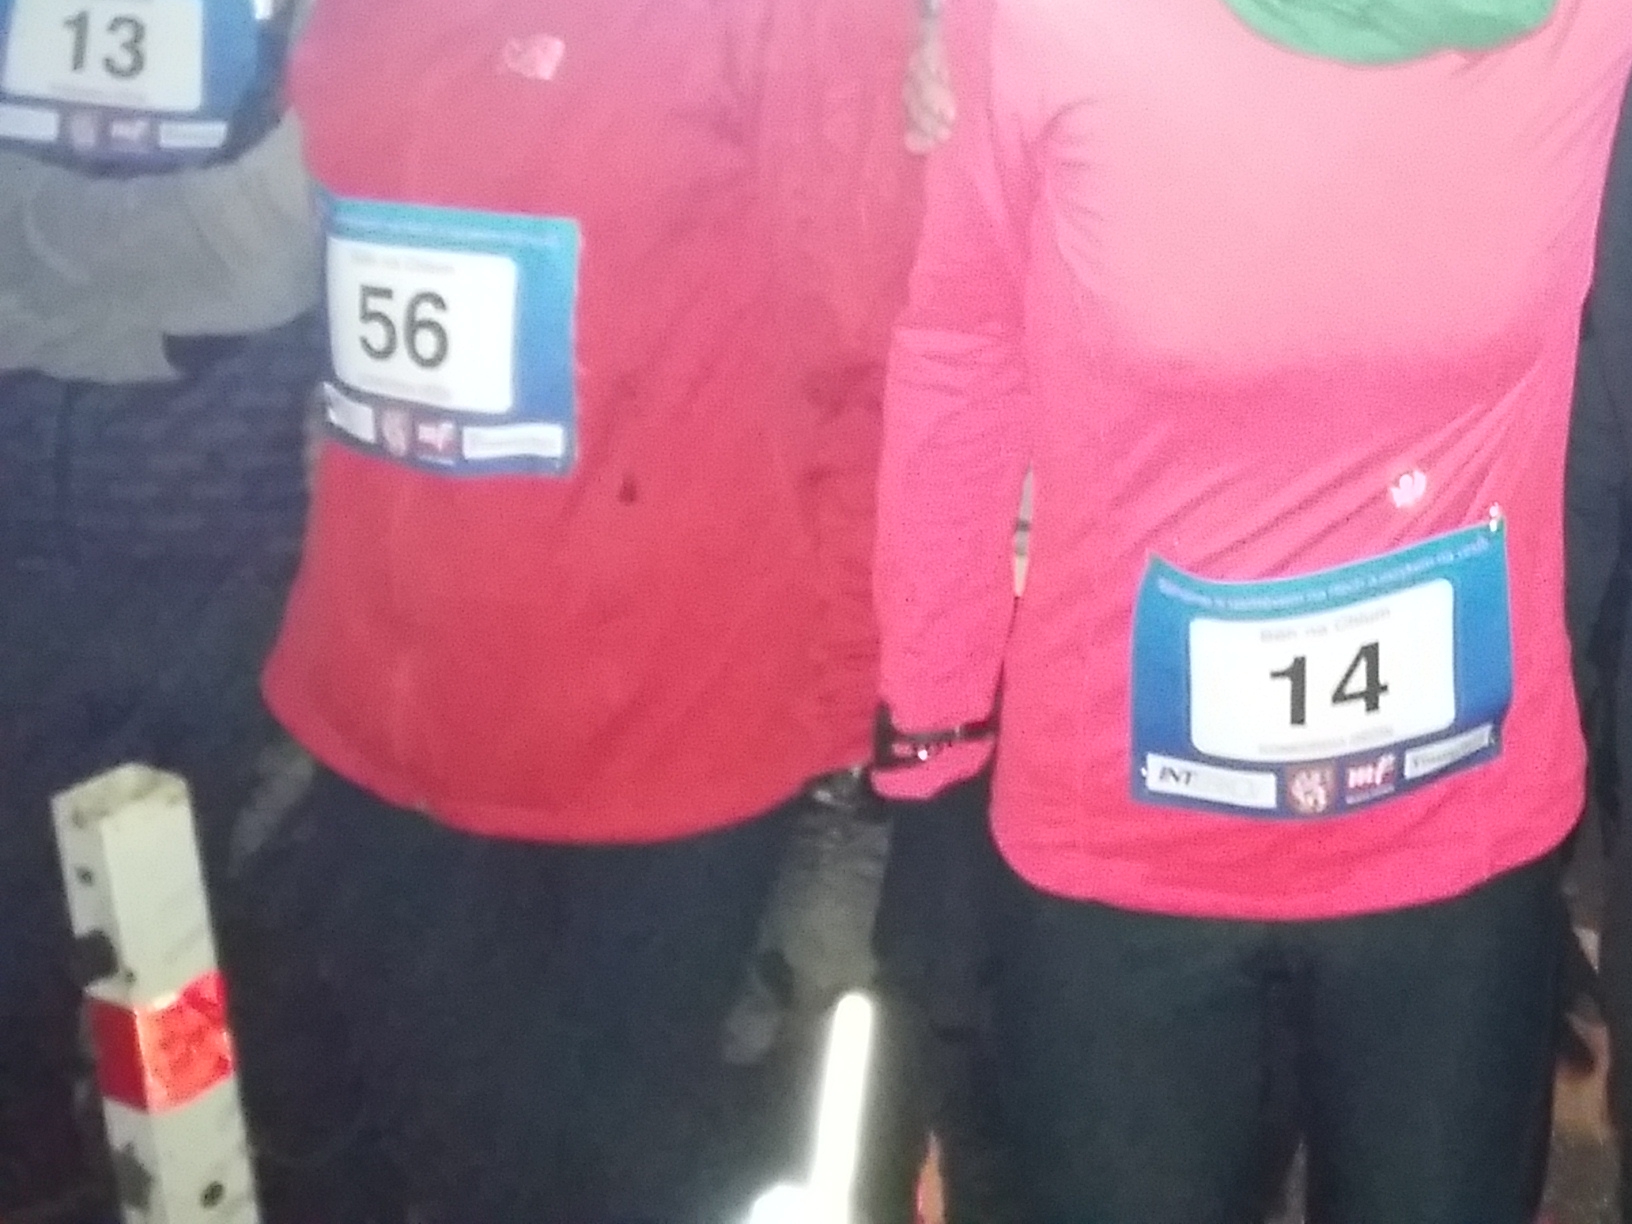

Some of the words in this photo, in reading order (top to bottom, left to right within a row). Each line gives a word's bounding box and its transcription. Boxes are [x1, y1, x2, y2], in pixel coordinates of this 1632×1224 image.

[62, 9, 147, 80] 13
[358, 284, 449, 370] 56
[1269, 640, 1389, 727] 14
